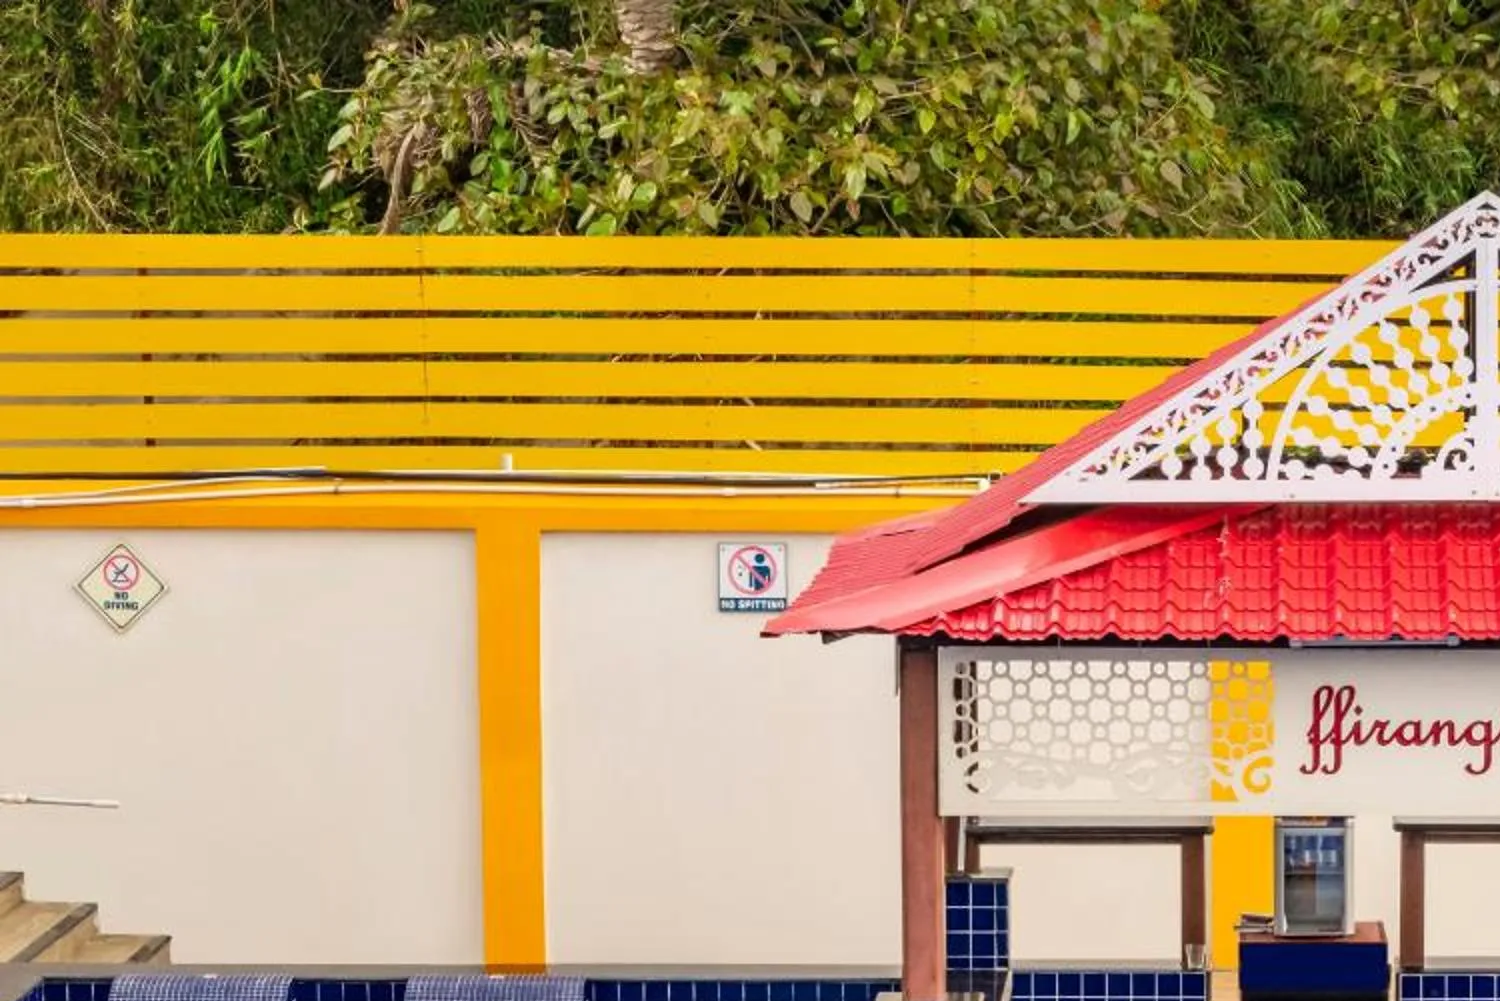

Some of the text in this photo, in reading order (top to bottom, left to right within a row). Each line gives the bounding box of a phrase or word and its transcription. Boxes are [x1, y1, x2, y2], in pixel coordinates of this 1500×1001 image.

[114, 591, 129, 600] NO
[103, 601, 139, 610] DIVING
[721, 600, 785, 609] NO SPITTING
